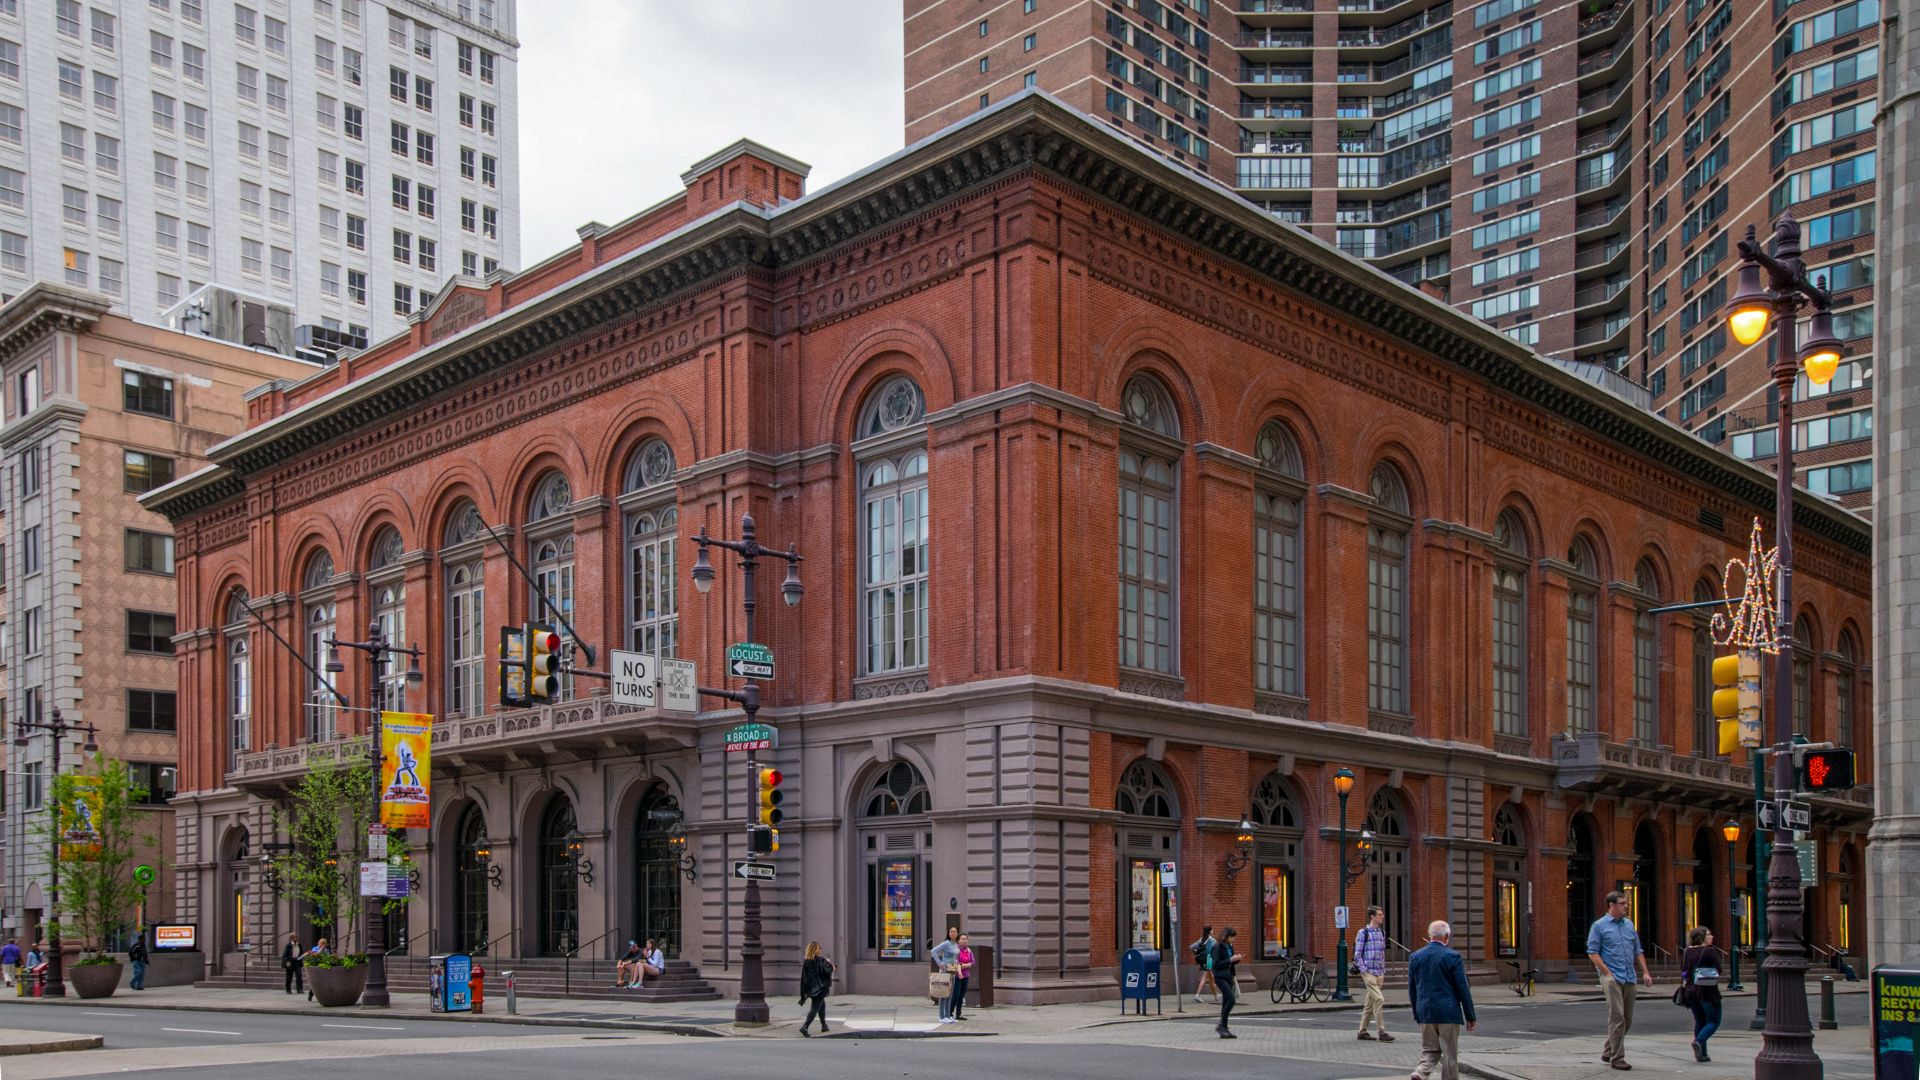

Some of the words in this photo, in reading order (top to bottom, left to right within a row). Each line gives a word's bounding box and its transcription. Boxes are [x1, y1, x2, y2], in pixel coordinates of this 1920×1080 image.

[731, 648, 763, 661] LOCUST
[623, 661, 645, 678] NO
[744, 664, 755, 672] ONE
[615, 681, 654, 699] TURNS
[733, 731, 760, 742] BROAD
[743, 742, 750, 750] OF
[750, 741, 758, 749] THE
[747, 867, 759, 875] ONE
[761, 869, 772, 877] WAY
[1881, 1010, 1905, 1022] INS
[1907, 1011, 1916, 1022] &
